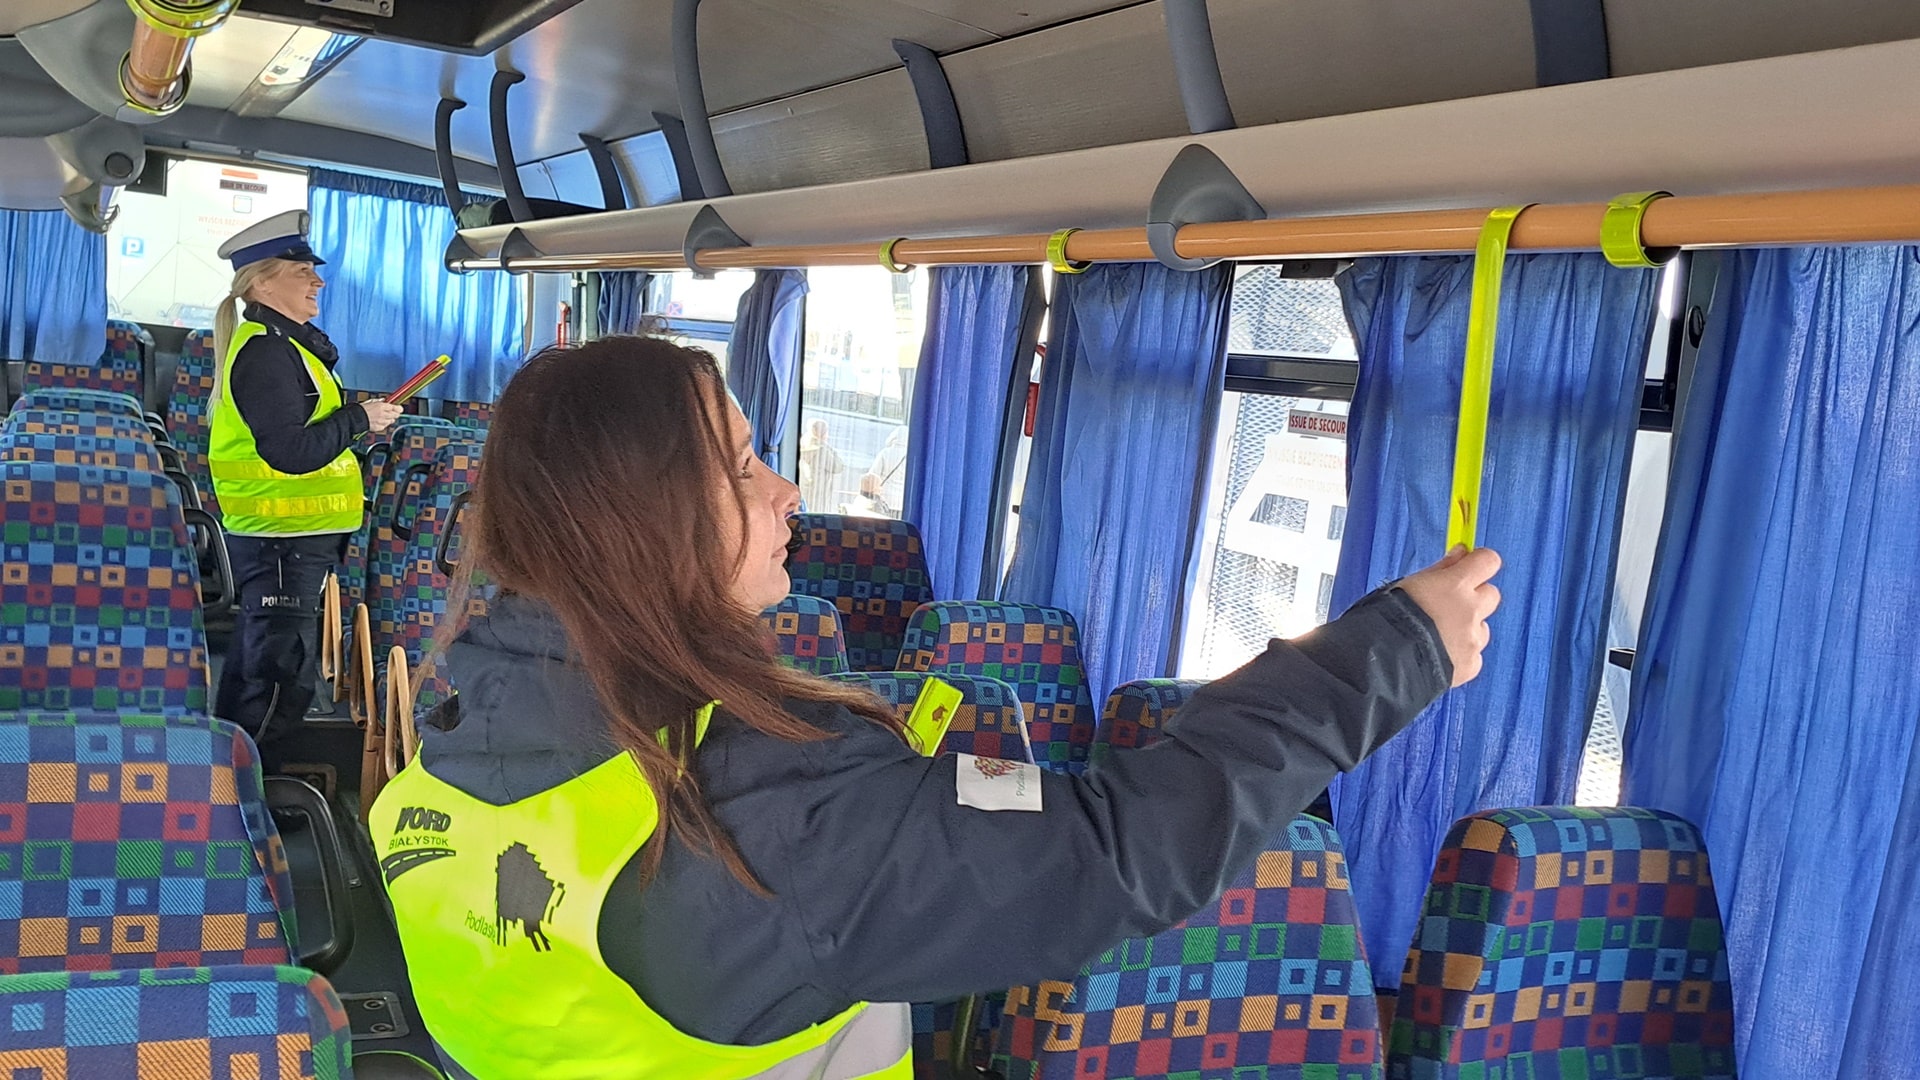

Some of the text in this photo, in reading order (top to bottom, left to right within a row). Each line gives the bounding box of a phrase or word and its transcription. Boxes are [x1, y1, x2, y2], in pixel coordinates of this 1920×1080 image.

[126, 239, 141, 255] P
[1289, 414, 1346, 434] ISSUE DE SECOUR
[261, 595, 301, 609] POLICJA
[388, 835, 449, 850] BIAŁYSTOK
